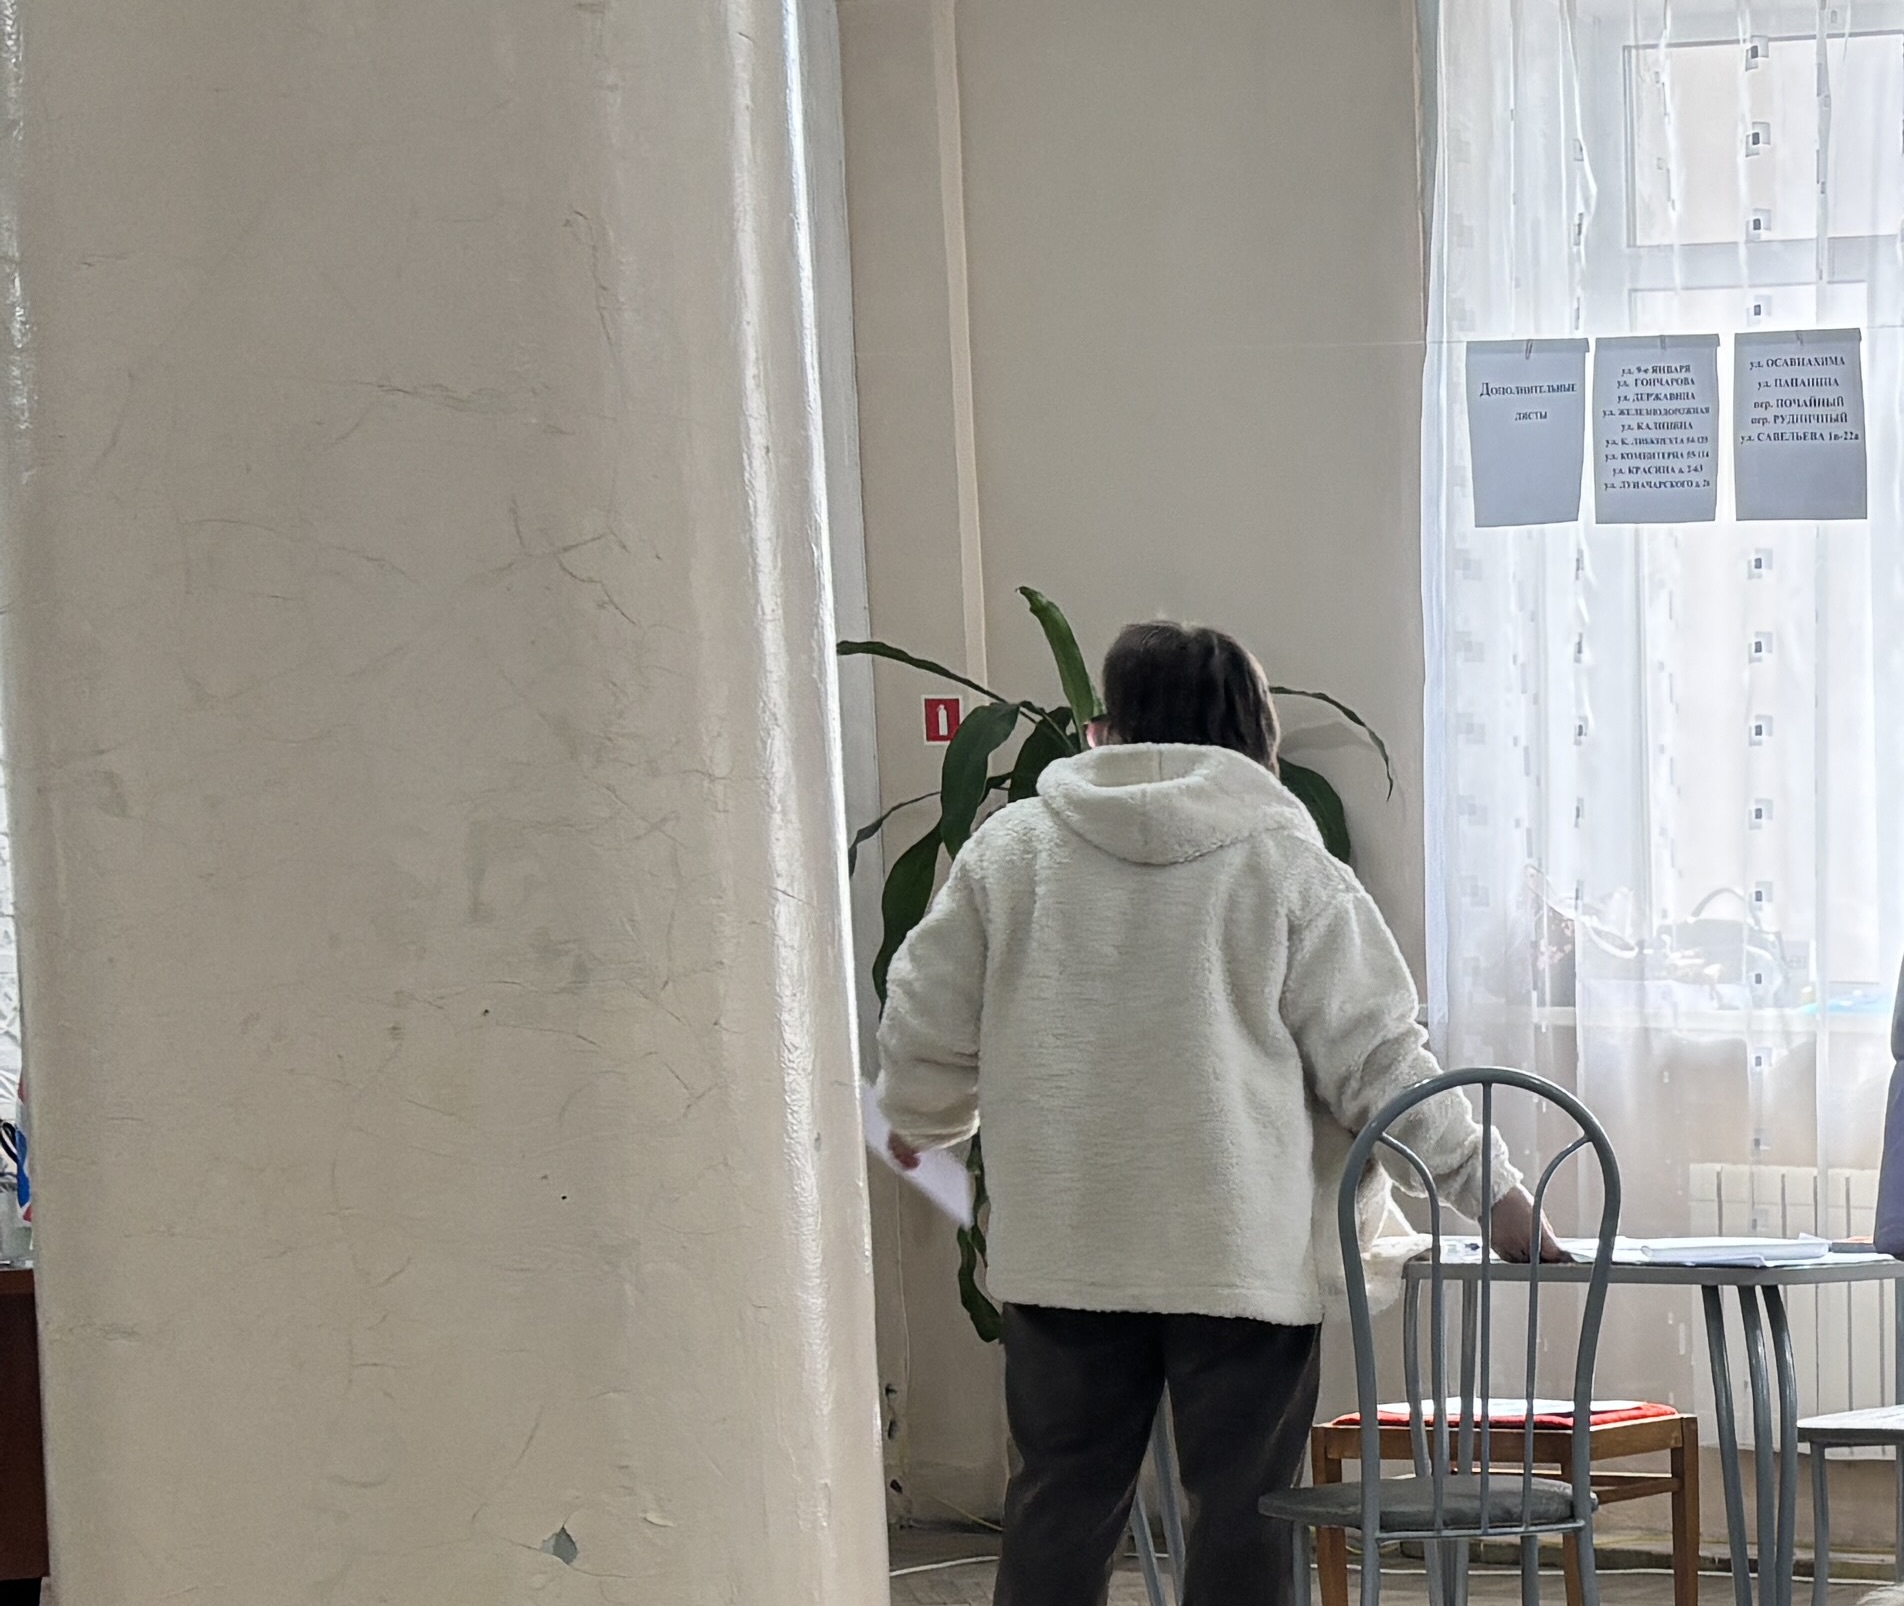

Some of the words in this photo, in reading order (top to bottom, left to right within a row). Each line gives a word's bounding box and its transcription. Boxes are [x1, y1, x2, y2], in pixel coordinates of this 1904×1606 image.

[1766, 356, 1846, 368] ОСАВИАХИМА
[1651, 364, 1691, 374] ЯНВАРЯ
[1634, 377, 1695, 388] ГОНЧАРОВА
[1774, 377, 1840, 388] ПАПАНИНА
[1632, 392, 1696, 402] ДЕРЖАВИНА
[1776, 395, 1845, 408] ПОЧАЙНЫЙ
[1773, 412, 1848, 425] РУДНИЧНЫЙ
[1757, 431, 1825, 442] САВЕЛЬЕВА
